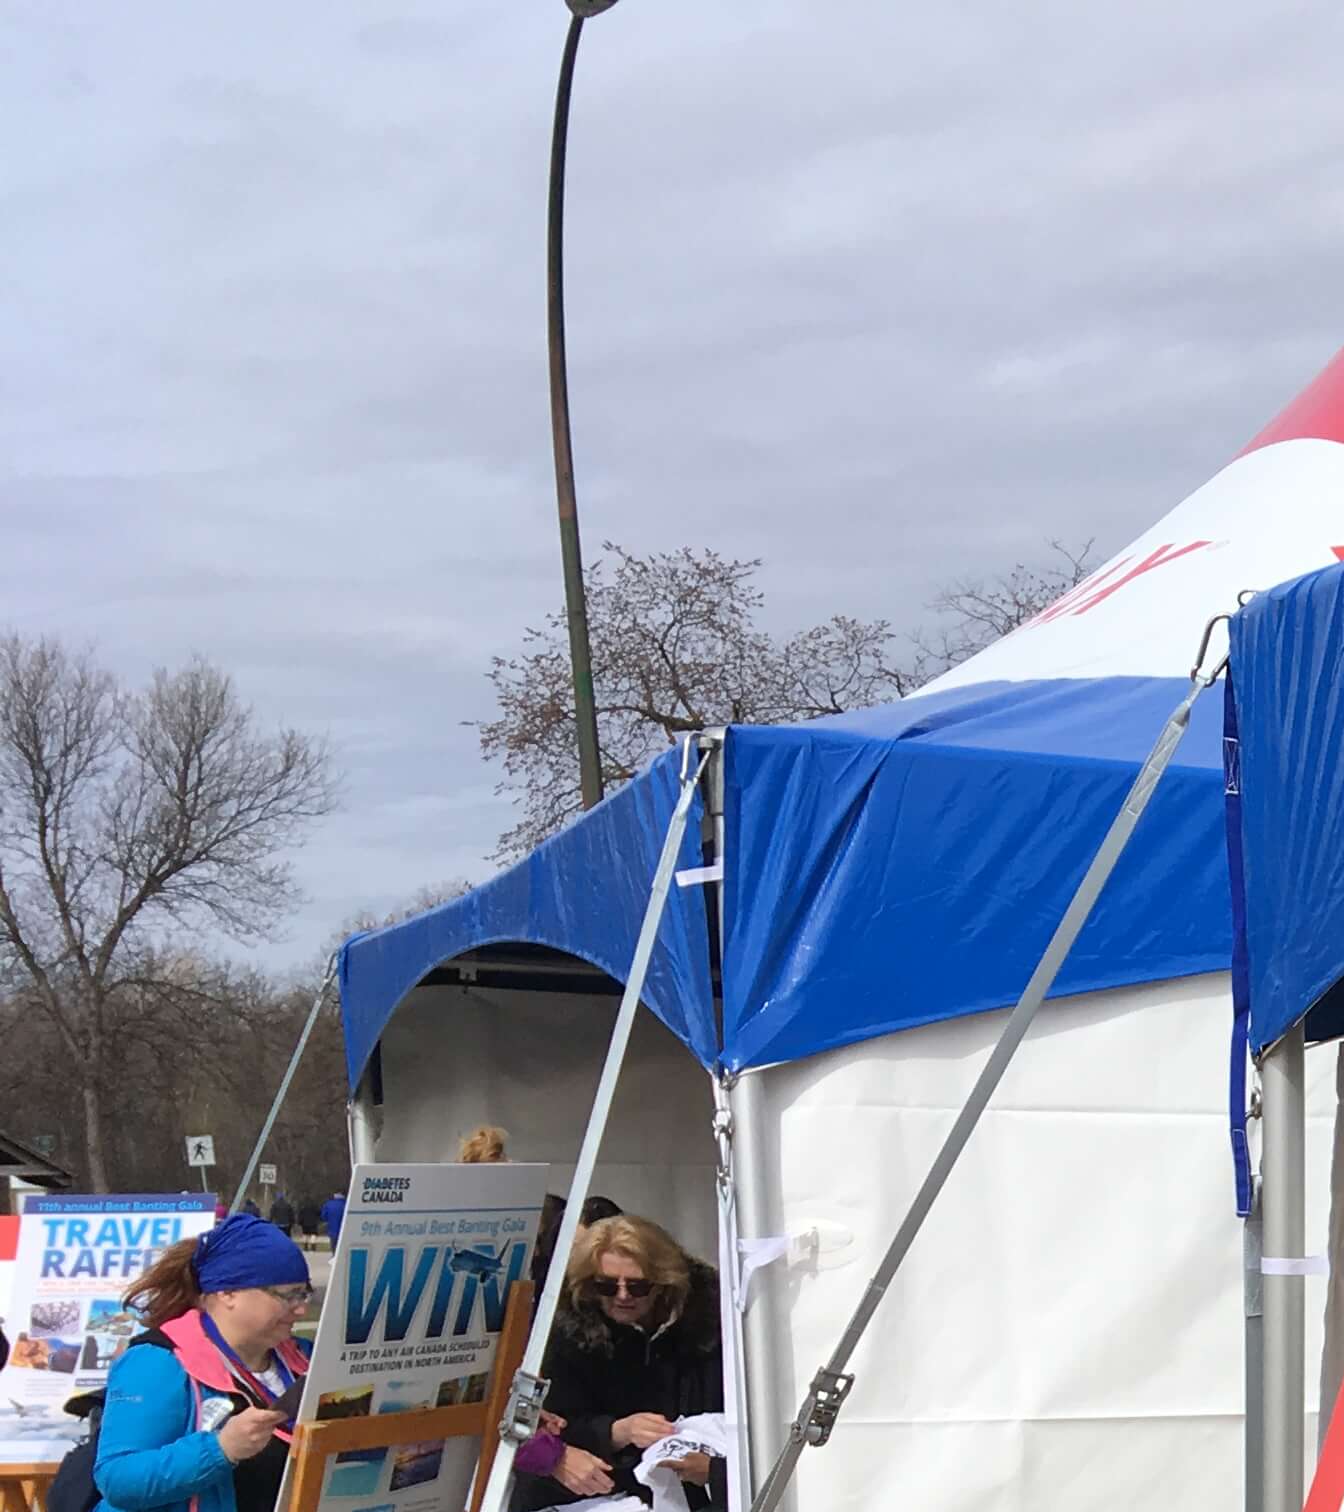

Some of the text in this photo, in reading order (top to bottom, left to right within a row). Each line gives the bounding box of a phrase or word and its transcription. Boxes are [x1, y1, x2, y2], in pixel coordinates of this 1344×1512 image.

[363, 1178, 410, 1190] DIABETES
[361, 1191, 403, 1202] CANADA
[361, 1217, 527, 1236] 9th Annual Best Banting Gala
[40, 1250, 152, 1278] RAFF
[345, 1242, 527, 1345] WIN
[349, 1351, 367, 1361] TRIP
[368, 1350, 380, 1360] TO
[381, 1348, 399, 1358] ANY
[415, 1343, 448, 1355] CANADA
[349, 1353, 476, 1375] DESTINATION IN NORTH AMERICA
